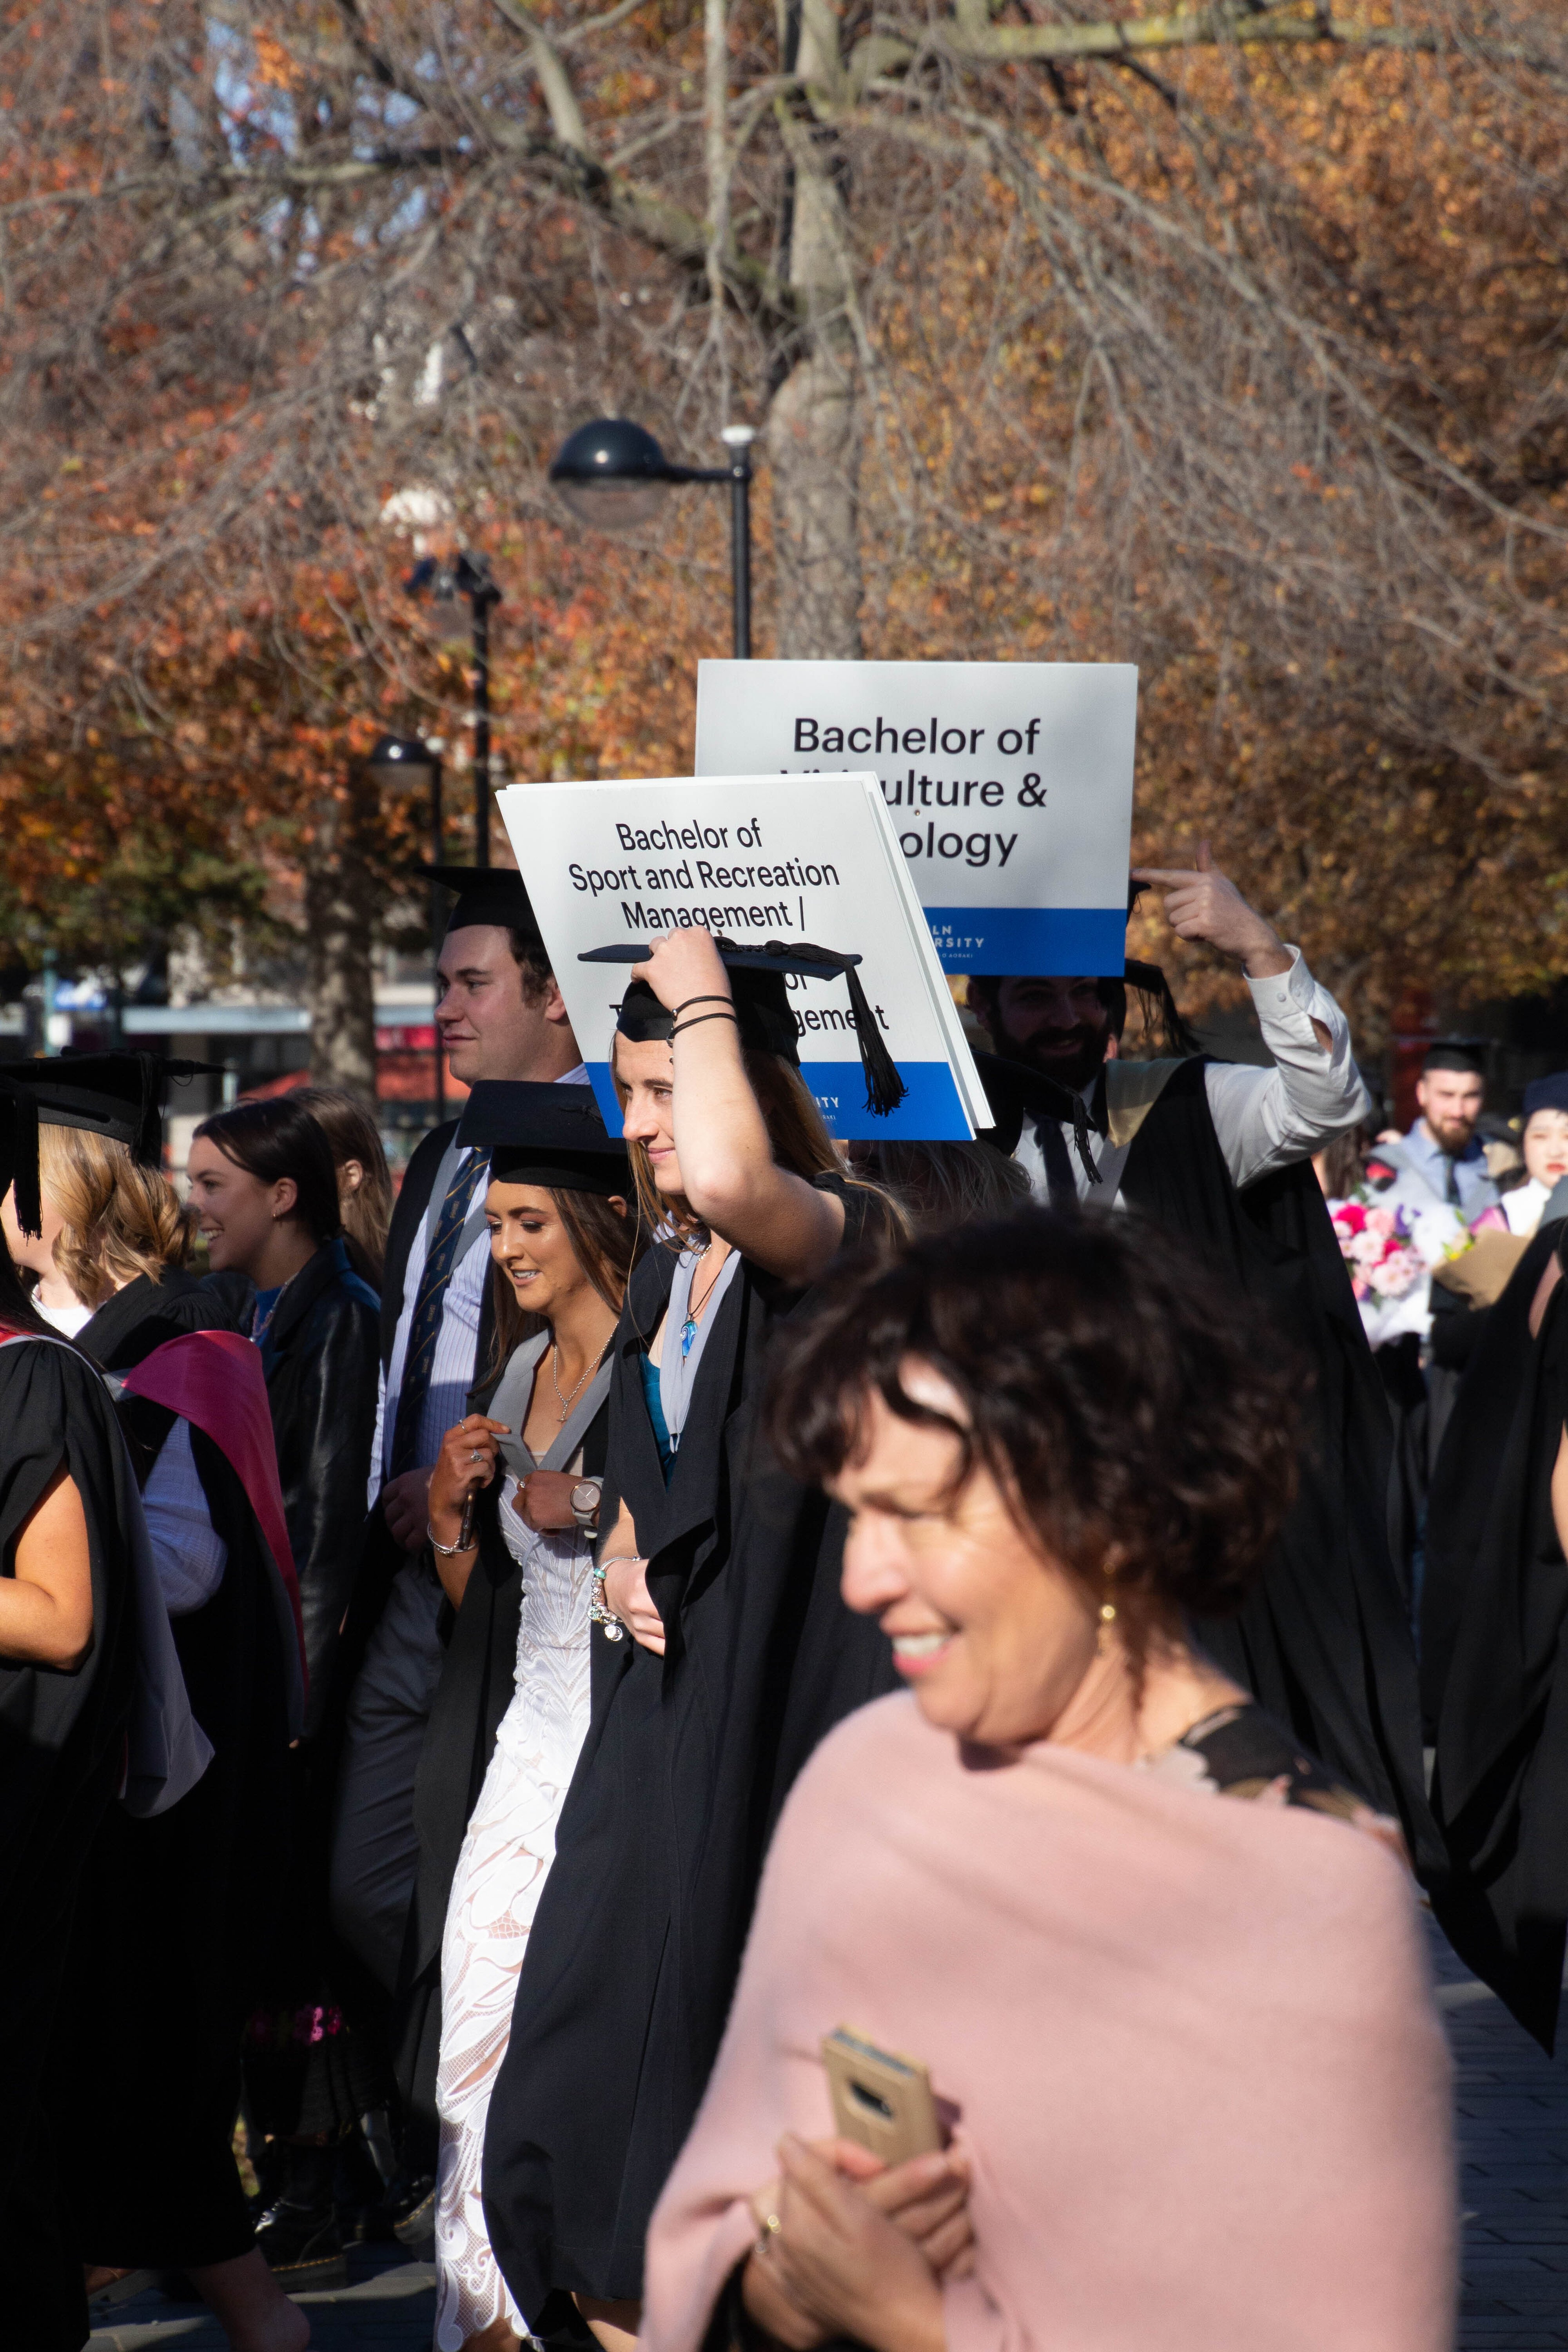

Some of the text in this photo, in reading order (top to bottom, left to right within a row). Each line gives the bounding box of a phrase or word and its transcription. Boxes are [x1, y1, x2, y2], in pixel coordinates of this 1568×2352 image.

[794, 717, 1041, 755] Bachelor of
[780, 769, 1047, 808] ulture &
[615, 818, 762, 851] Bachelor of
[899, 822, 1018, 868] ology
[569, 857, 840, 897] Sport and Recreation
[621, 902, 793, 933] Management
